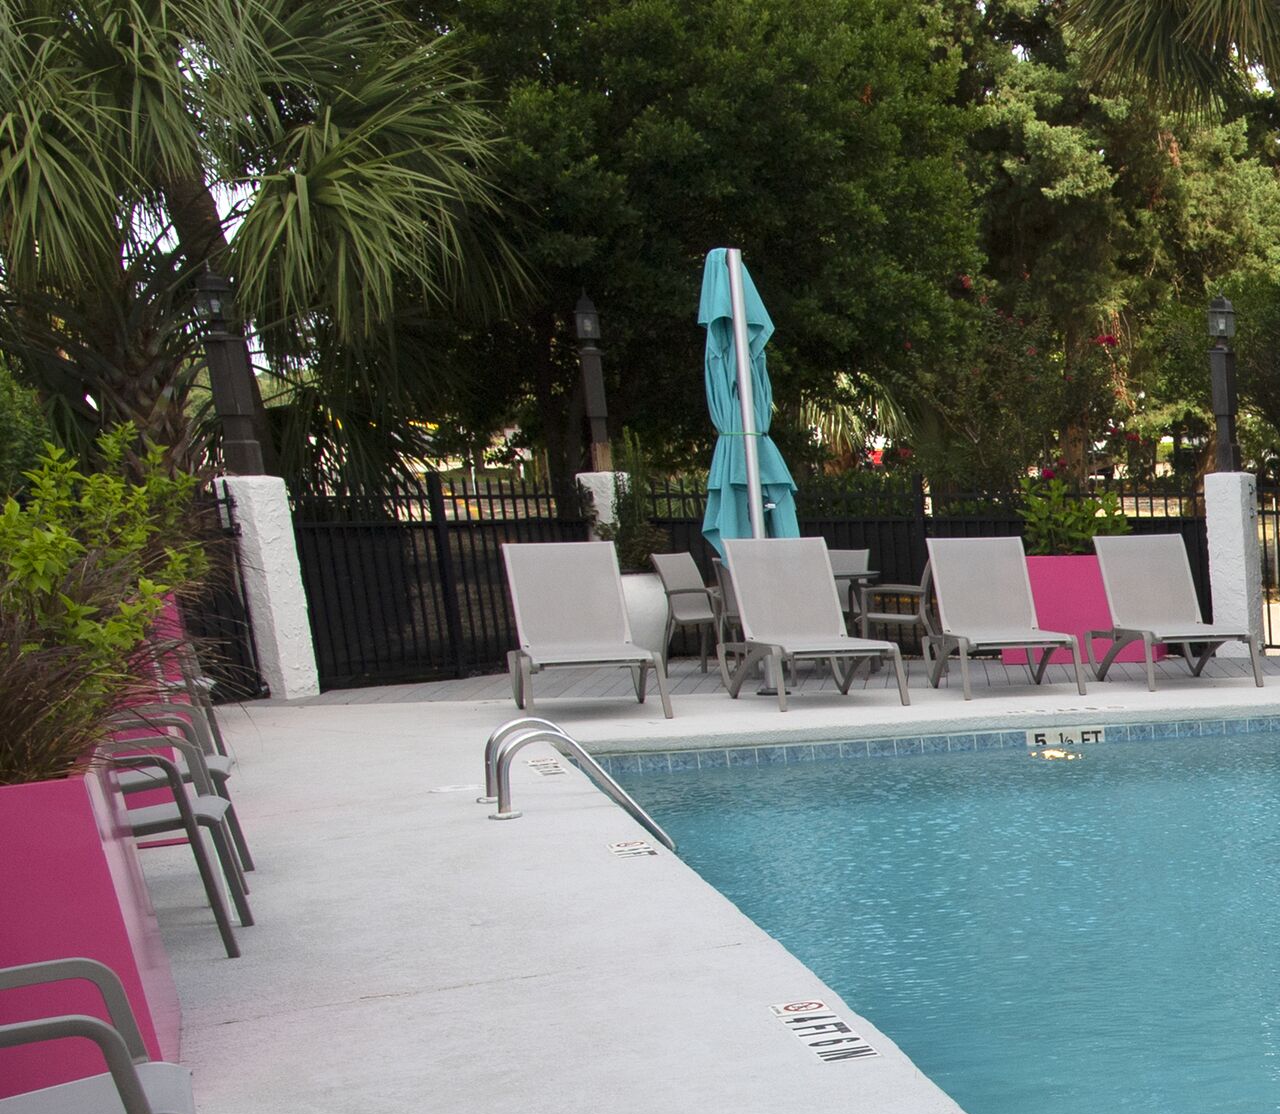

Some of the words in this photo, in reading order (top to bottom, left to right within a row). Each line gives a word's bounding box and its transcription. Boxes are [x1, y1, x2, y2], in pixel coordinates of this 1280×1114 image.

[1034, 733, 1047, 746] 5
[1081, 730, 1102, 744] FT
[785, 1015, 837, 1024] 4
[792, 1021, 852, 1037] FT
[808, 1037, 861, 1047] 6
[816, 1045, 878, 1062] IN
